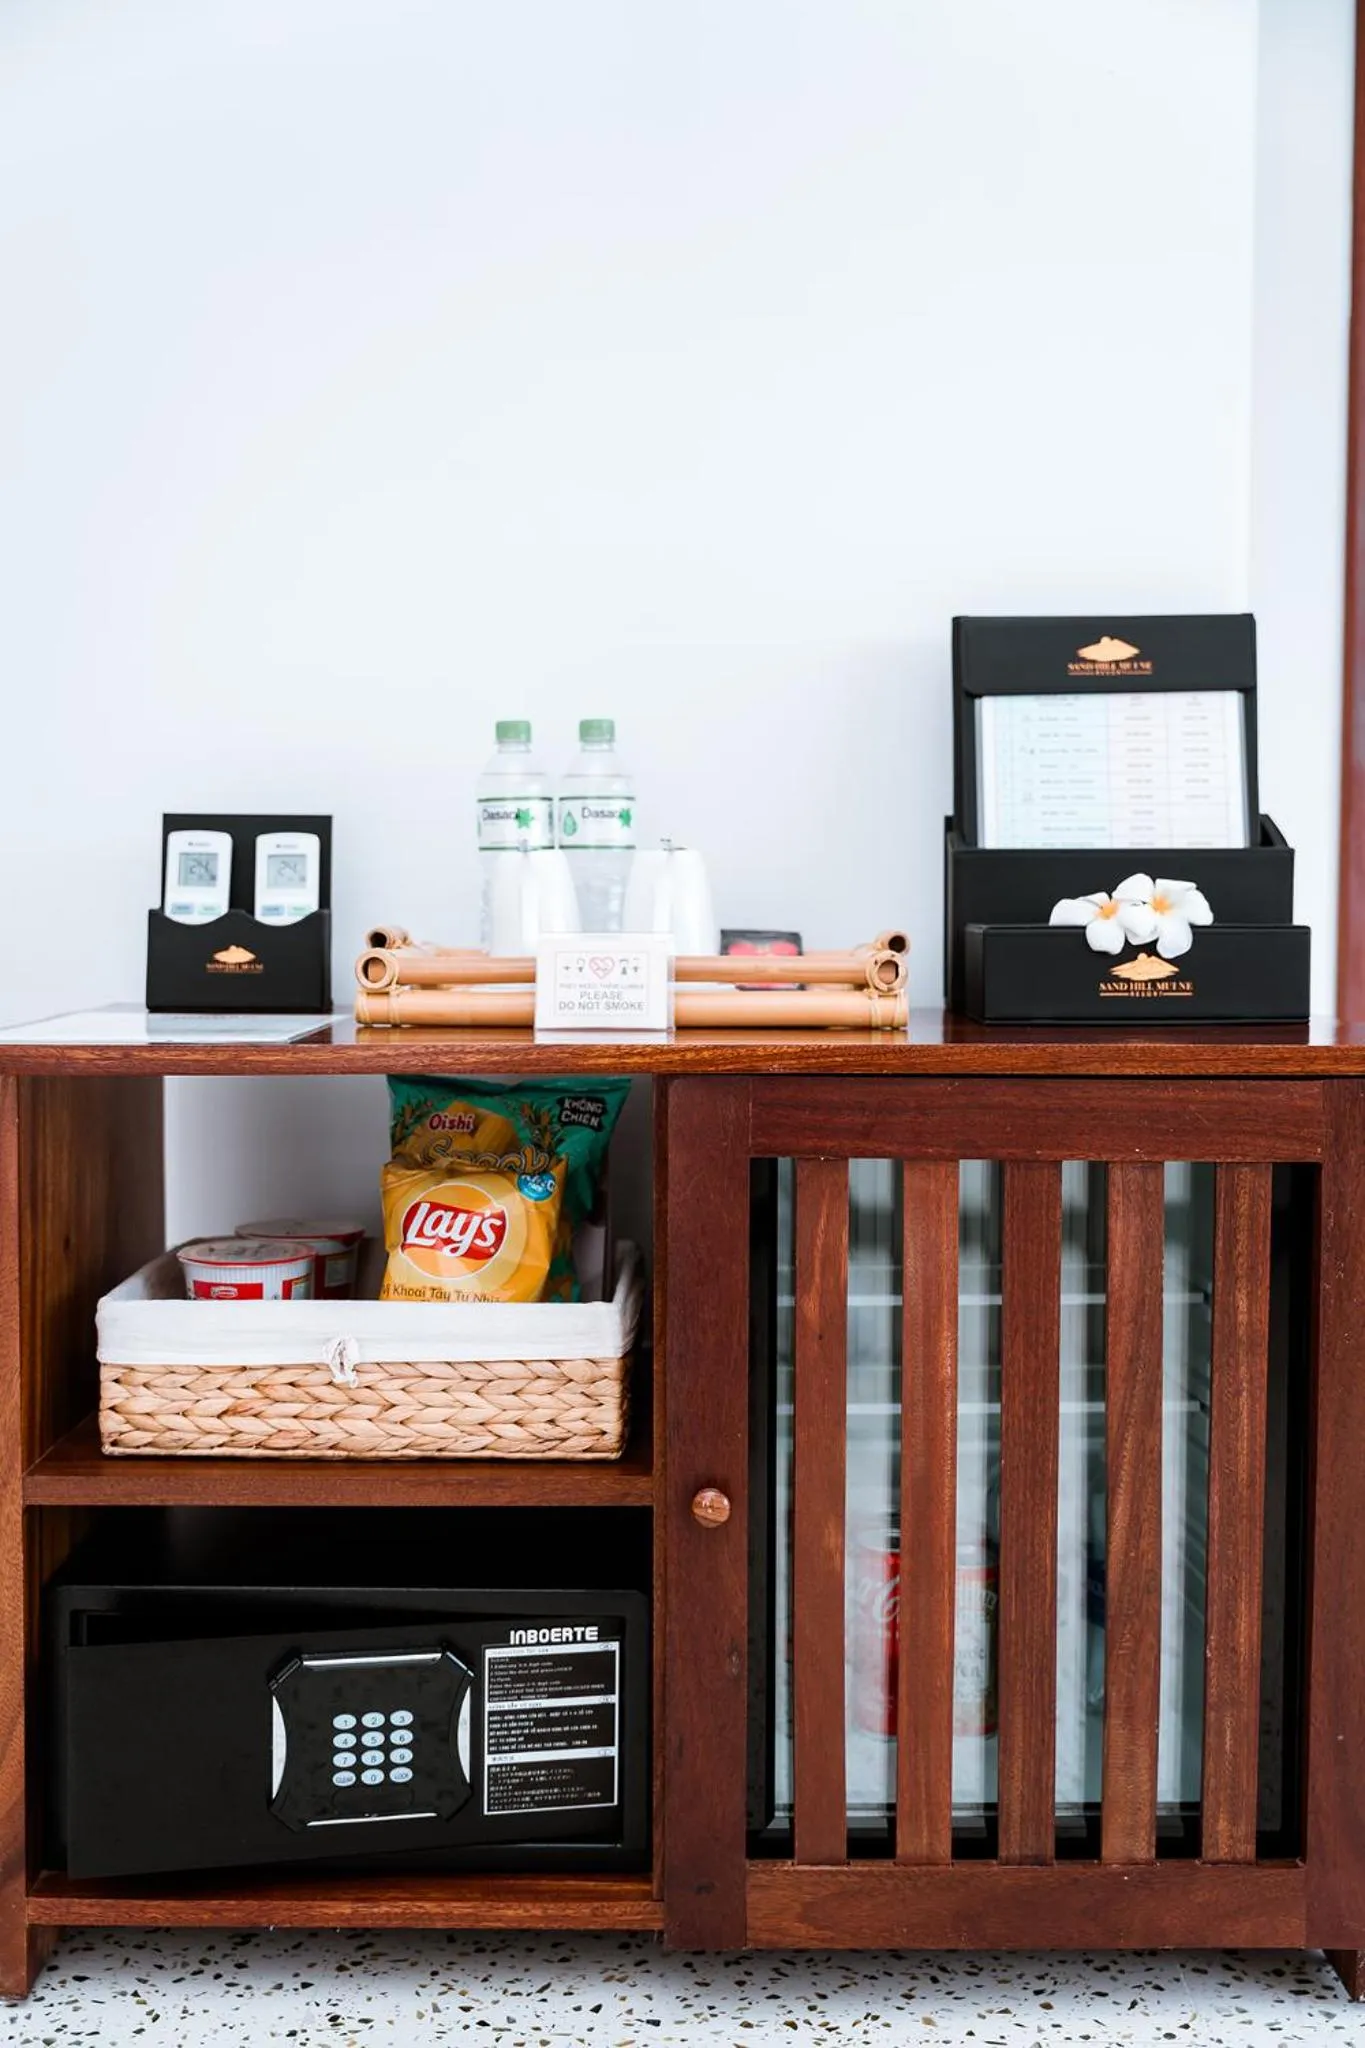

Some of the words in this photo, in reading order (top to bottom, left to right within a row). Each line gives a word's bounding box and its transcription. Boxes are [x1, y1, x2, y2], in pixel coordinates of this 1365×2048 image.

[579, 990, 624, 1000] PLEASE
[559, 1001, 575, 1010] DO
[578, 1001, 601, 1010] NOT
[605, 1001, 644, 1010] SMOKE
[429, 1114, 474, 1132] Oishi
[404, 1203, 500, 1257] Lay's
[510, 1626, 599, 1646] INBOERTE
